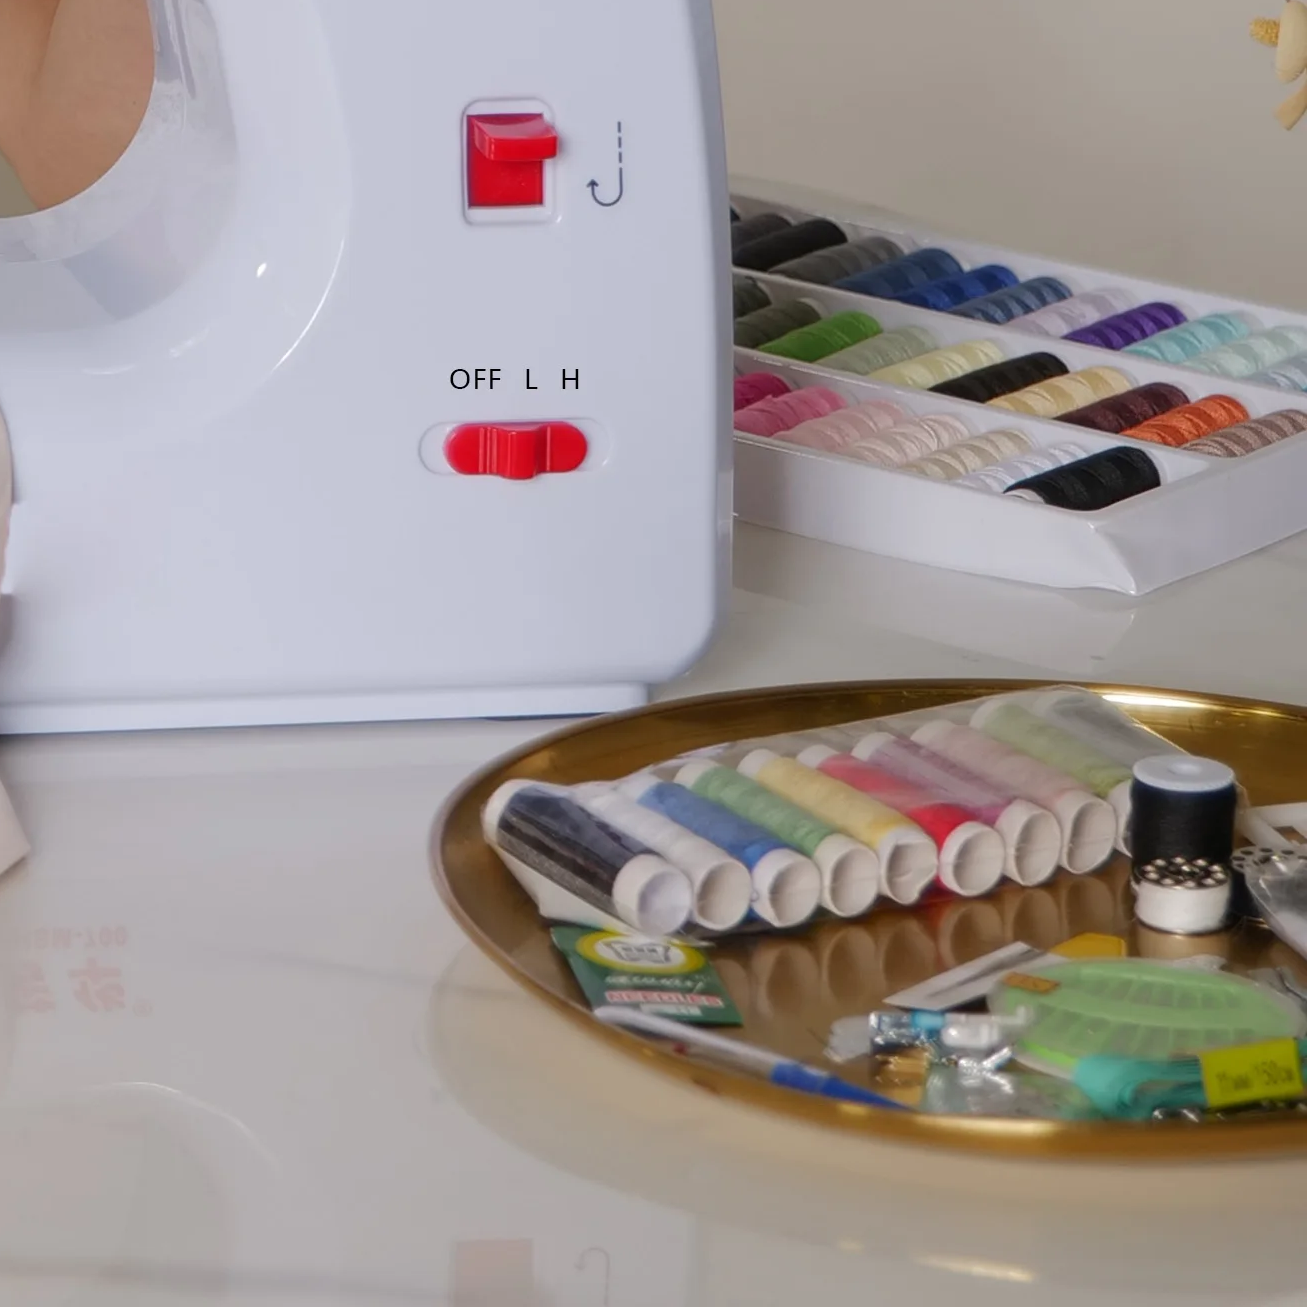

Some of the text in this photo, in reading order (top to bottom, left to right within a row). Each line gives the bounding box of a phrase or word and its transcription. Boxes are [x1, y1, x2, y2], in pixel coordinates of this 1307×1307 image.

[450, 368, 580, 390] OFF L H
